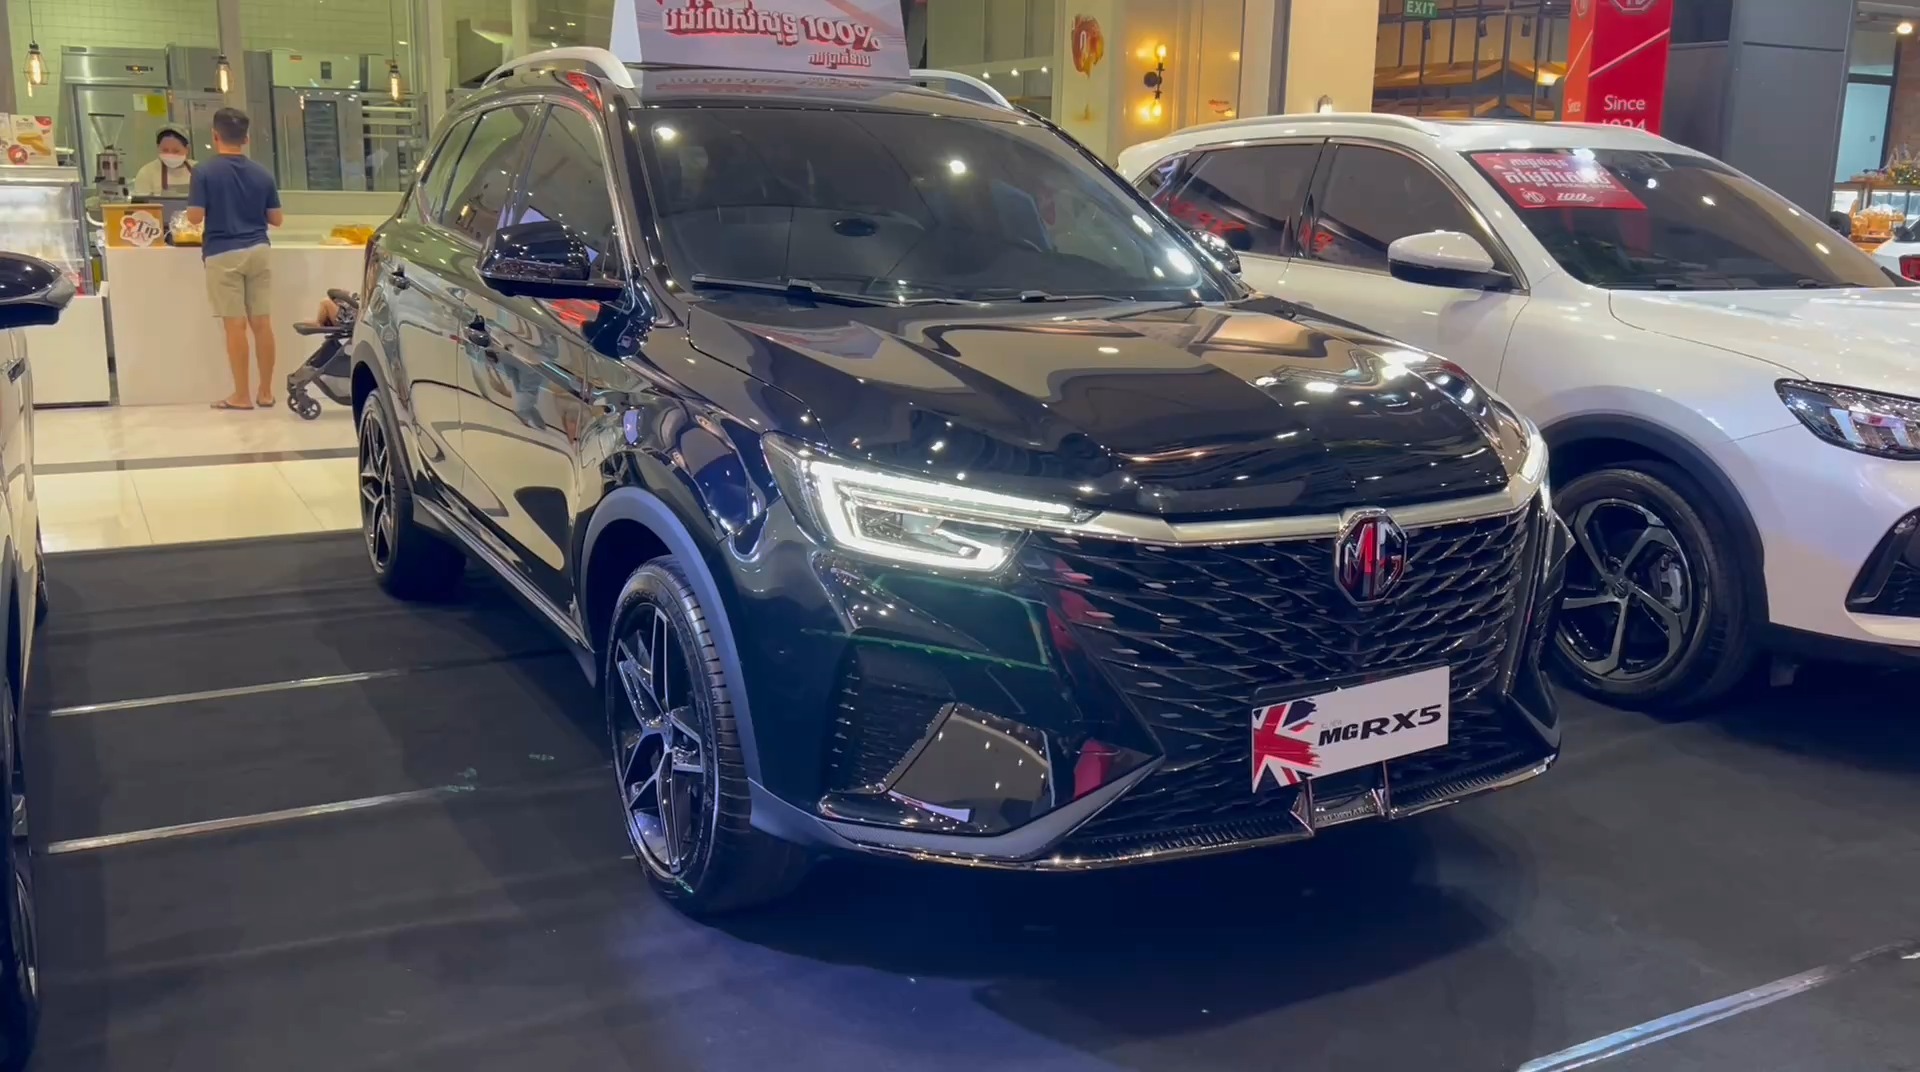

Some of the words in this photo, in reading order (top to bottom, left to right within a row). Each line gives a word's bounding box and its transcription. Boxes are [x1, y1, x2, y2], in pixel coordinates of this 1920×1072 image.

[1406, 1, 1435, 15] EXIT
[803, 14, 883, 50] 100%
[1603, 94, 1646, 111] Since
[135, 220, 160, 238] Tip
[1341, 519, 1405, 601] MG
